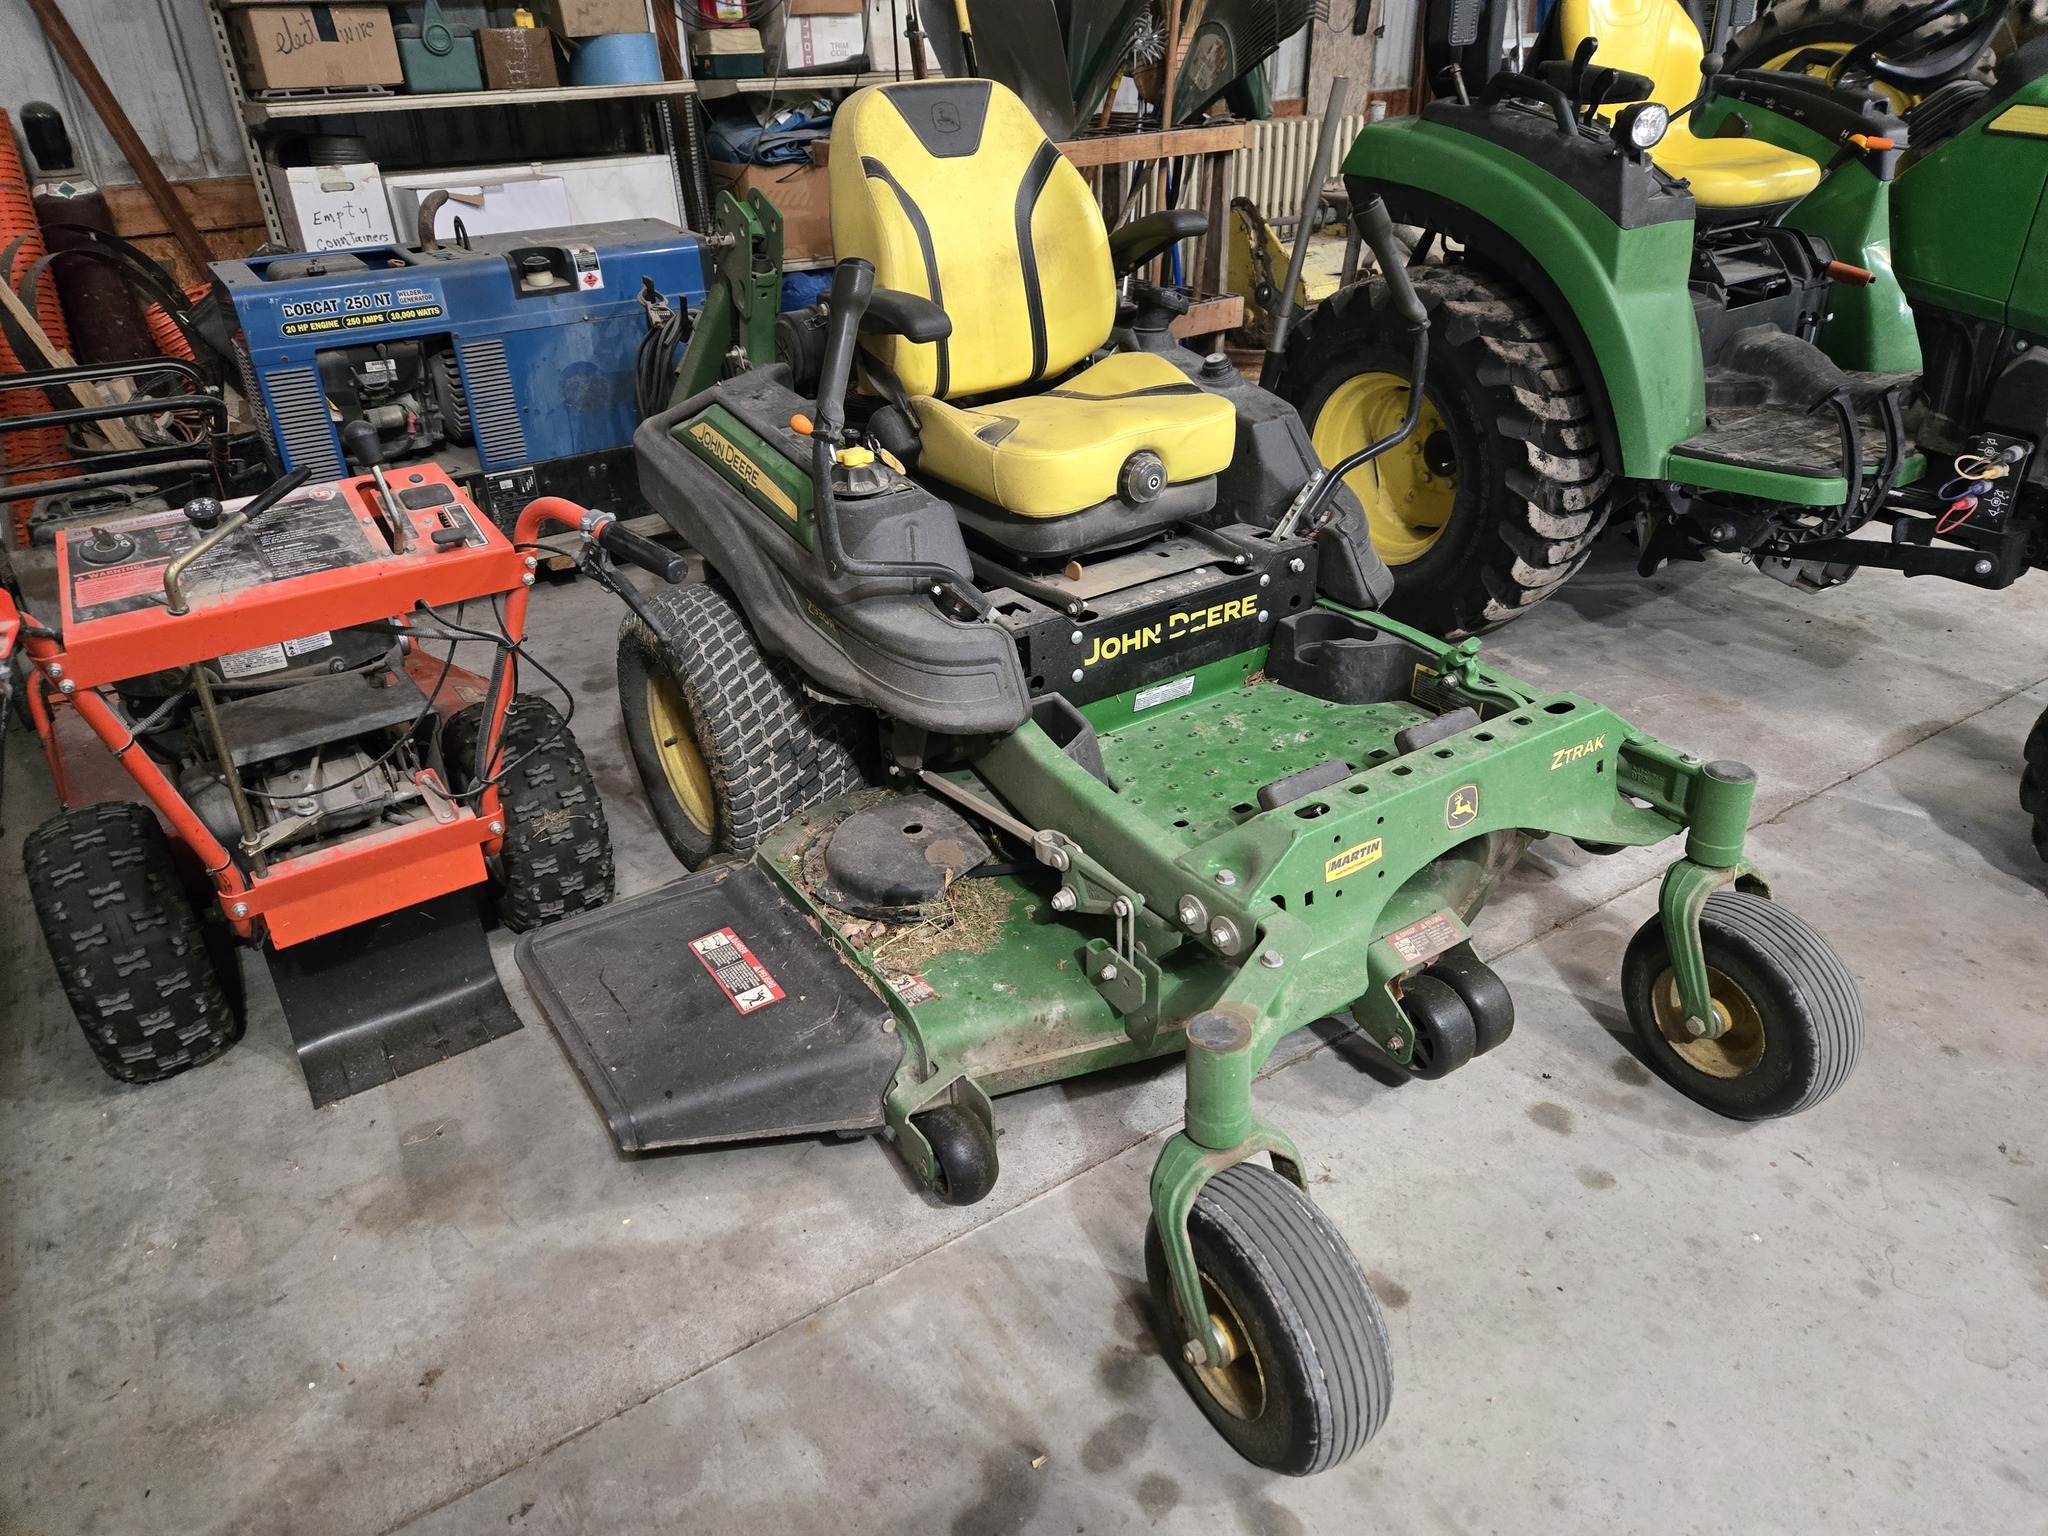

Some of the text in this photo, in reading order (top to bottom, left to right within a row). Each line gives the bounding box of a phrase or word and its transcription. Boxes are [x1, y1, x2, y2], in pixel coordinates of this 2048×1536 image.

[338, 18, 375, 44] wire
[830, 41, 849, 50] TRIM
[830, 49, 849, 57] COIL
[313, 200, 371, 230] Empty
[398, 289, 422, 297] WELDER
[399, 294, 433, 303] GENERATOR
[283, 293, 392, 318] BOBCAT 250 NT
[346, 314, 384, 326] 250 AMPS
[390, 306, 440, 321] 10,000 WATTS
[285, 319, 340, 334] 20 HP ENGINE
[698, 425, 760, 487] JOHN DEERE
[135, 514, 165, 525] BRUSH
[88, 563, 145, 579] WARNING!
[1084, 621, 1162, 667] JOHN
[1169, 593, 1258, 640] DEERE
[1550, 733, 1607, 771] ZTRAK
[1329, 840, 1381, 872] MARTIN
